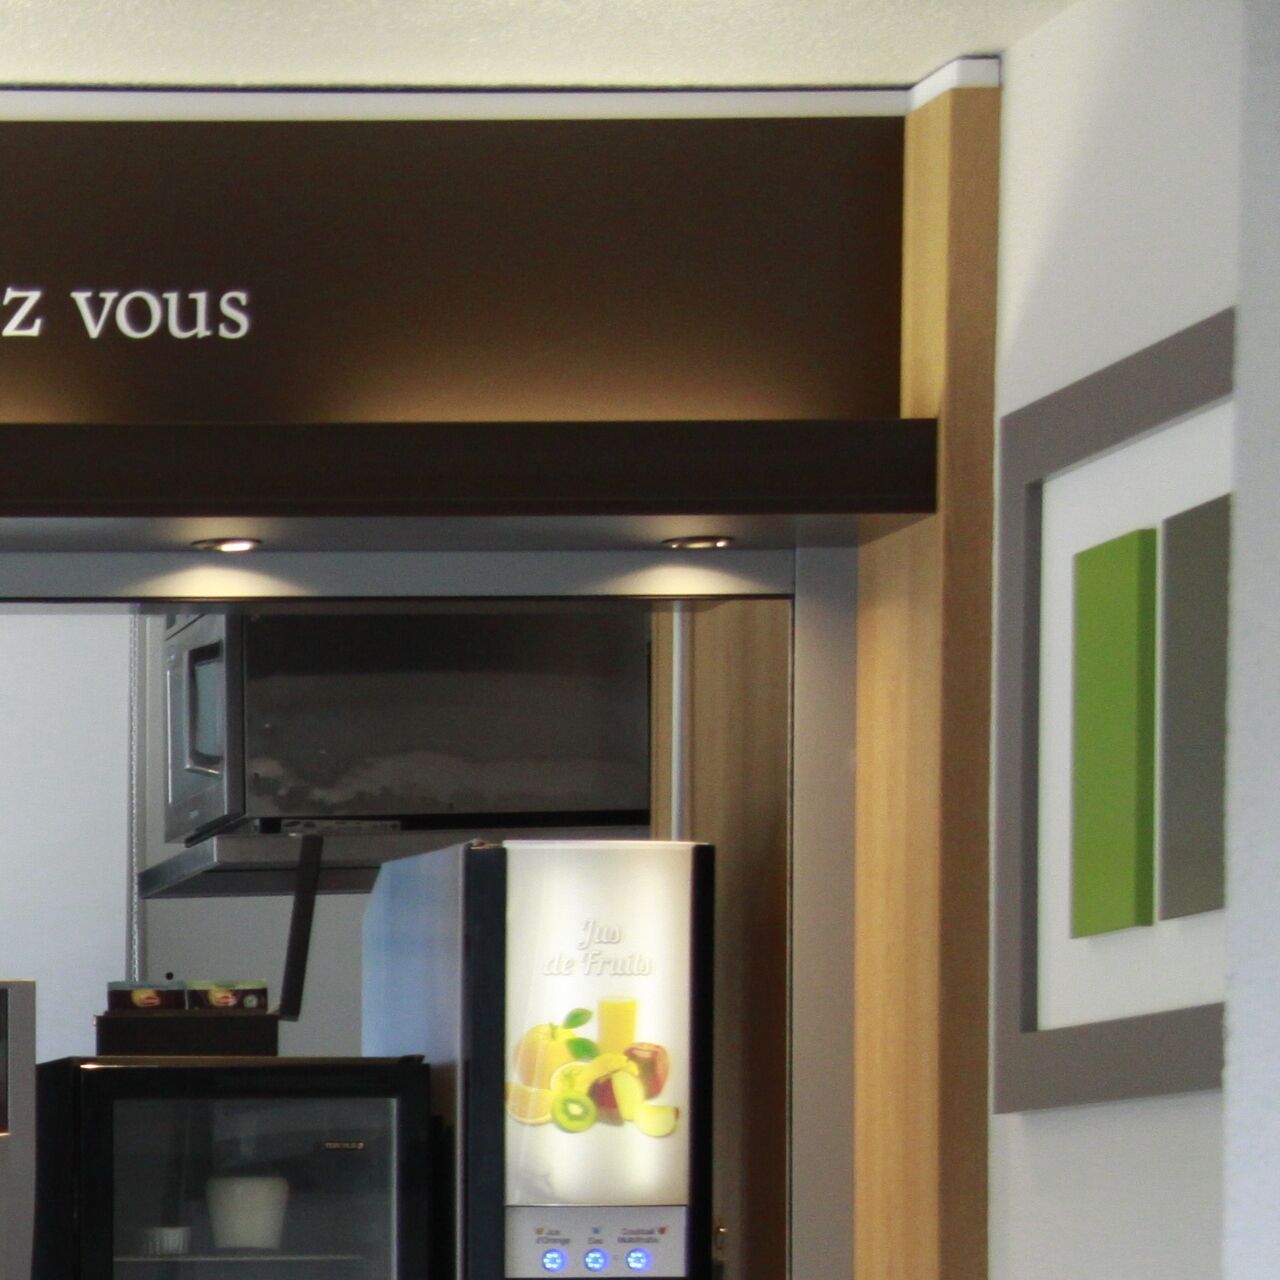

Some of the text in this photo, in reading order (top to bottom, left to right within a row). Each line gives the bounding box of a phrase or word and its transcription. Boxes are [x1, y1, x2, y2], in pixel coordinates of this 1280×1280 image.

[70, 290, 249, 339] vous
[576, 919, 623, 950] Jus
[543, 951, 652, 977] de Fruits
